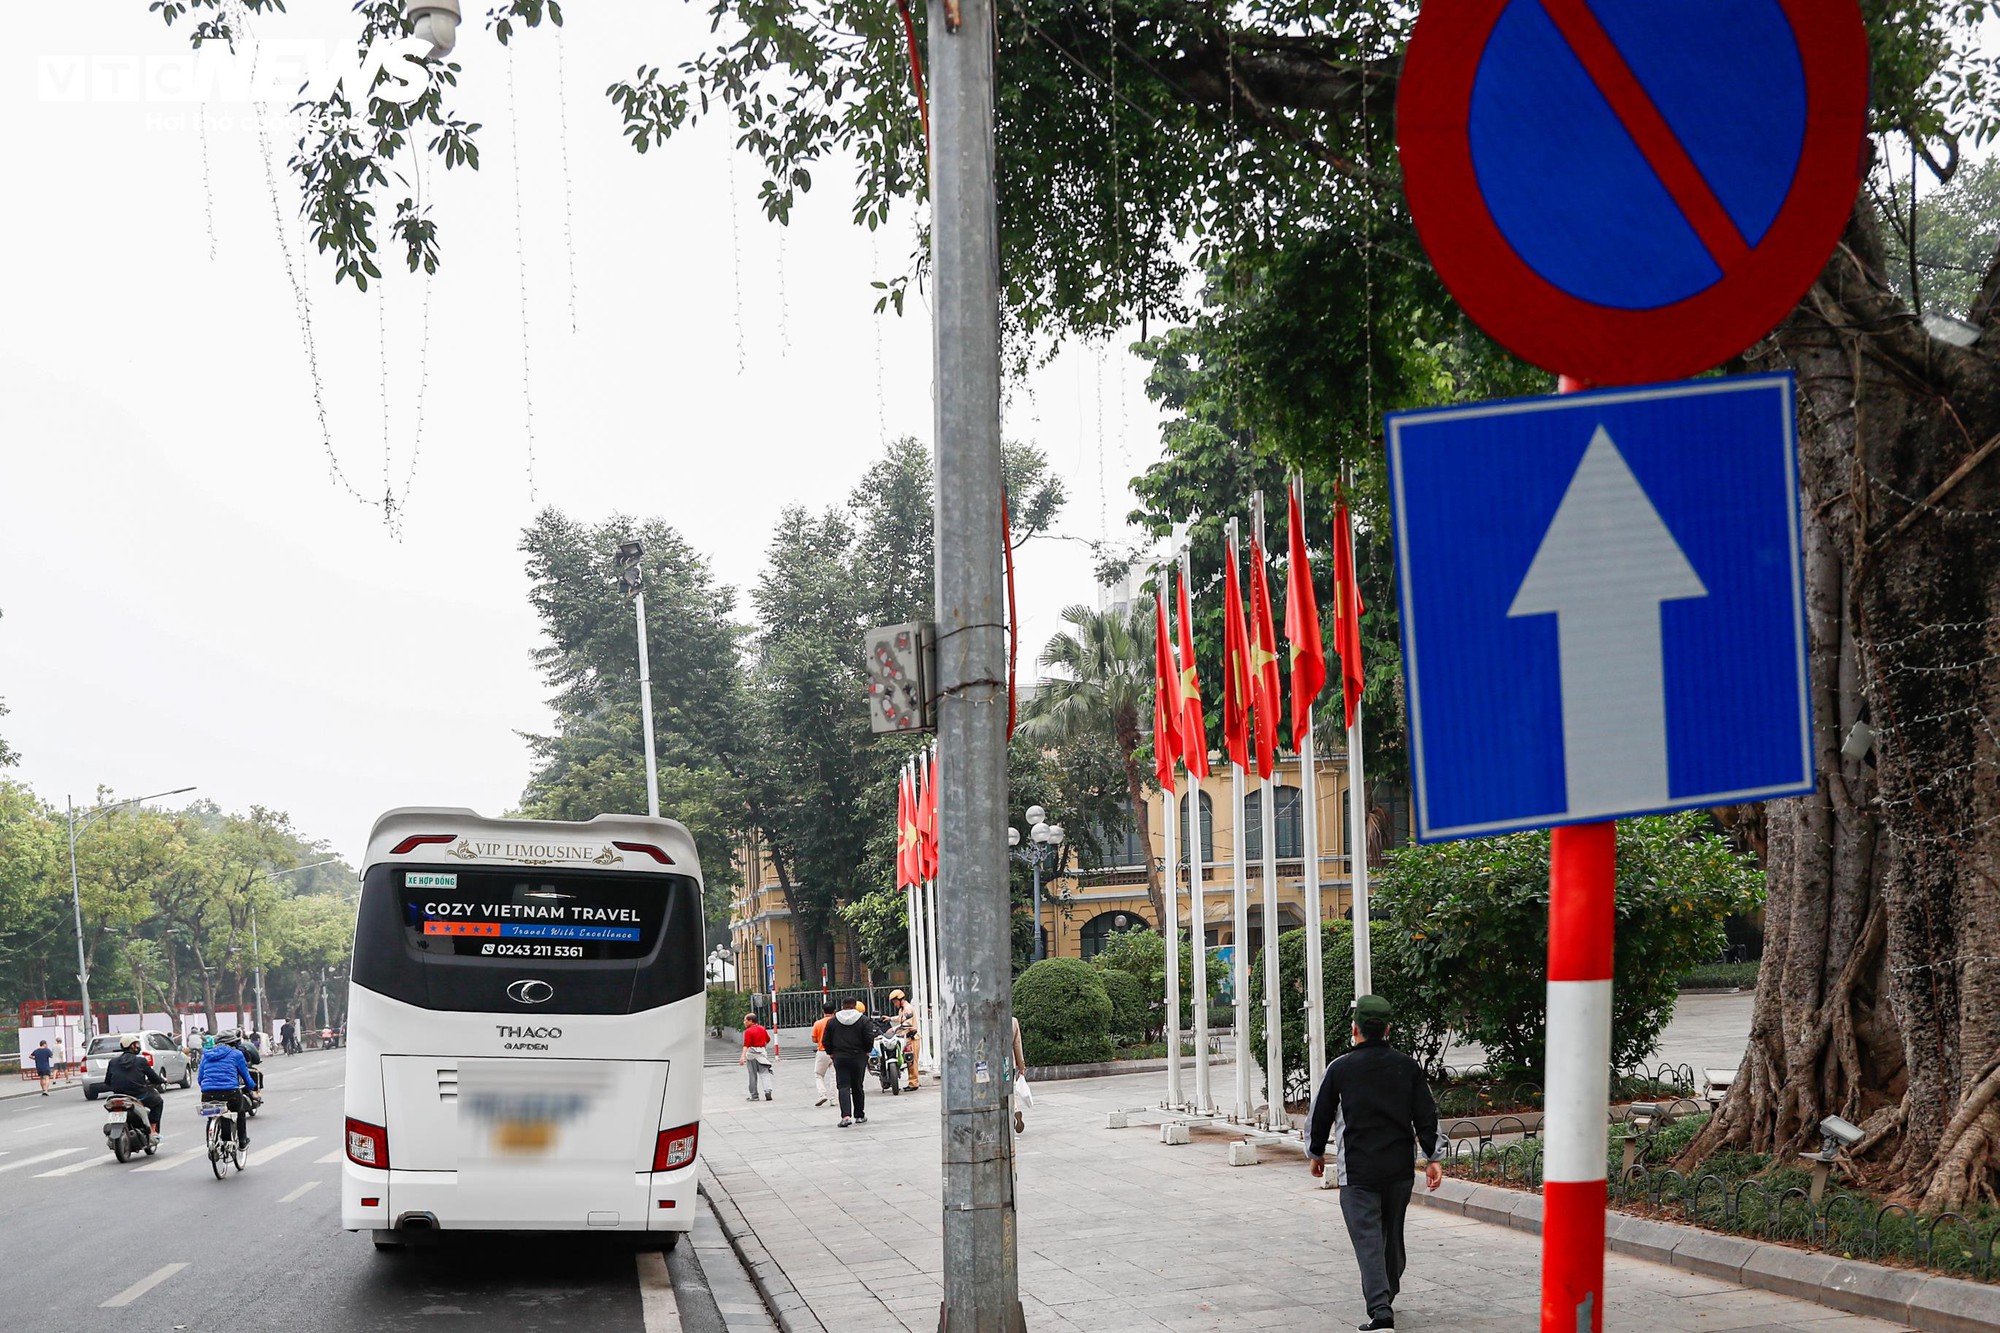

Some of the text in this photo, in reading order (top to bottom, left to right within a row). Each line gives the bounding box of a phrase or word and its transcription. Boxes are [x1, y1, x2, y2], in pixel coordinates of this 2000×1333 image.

[476, 842, 593, 860] VIP LIMOUSINE
[408, 876, 417, 885] XE
[424, 902, 641, 922] COZY VIETNAM TRAVEL
[512, 926, 633, 939] Travel With Excellence
[497, 944, 584, 958] 0243 211 5361
[495, 1024, 563, 1039] THACO
